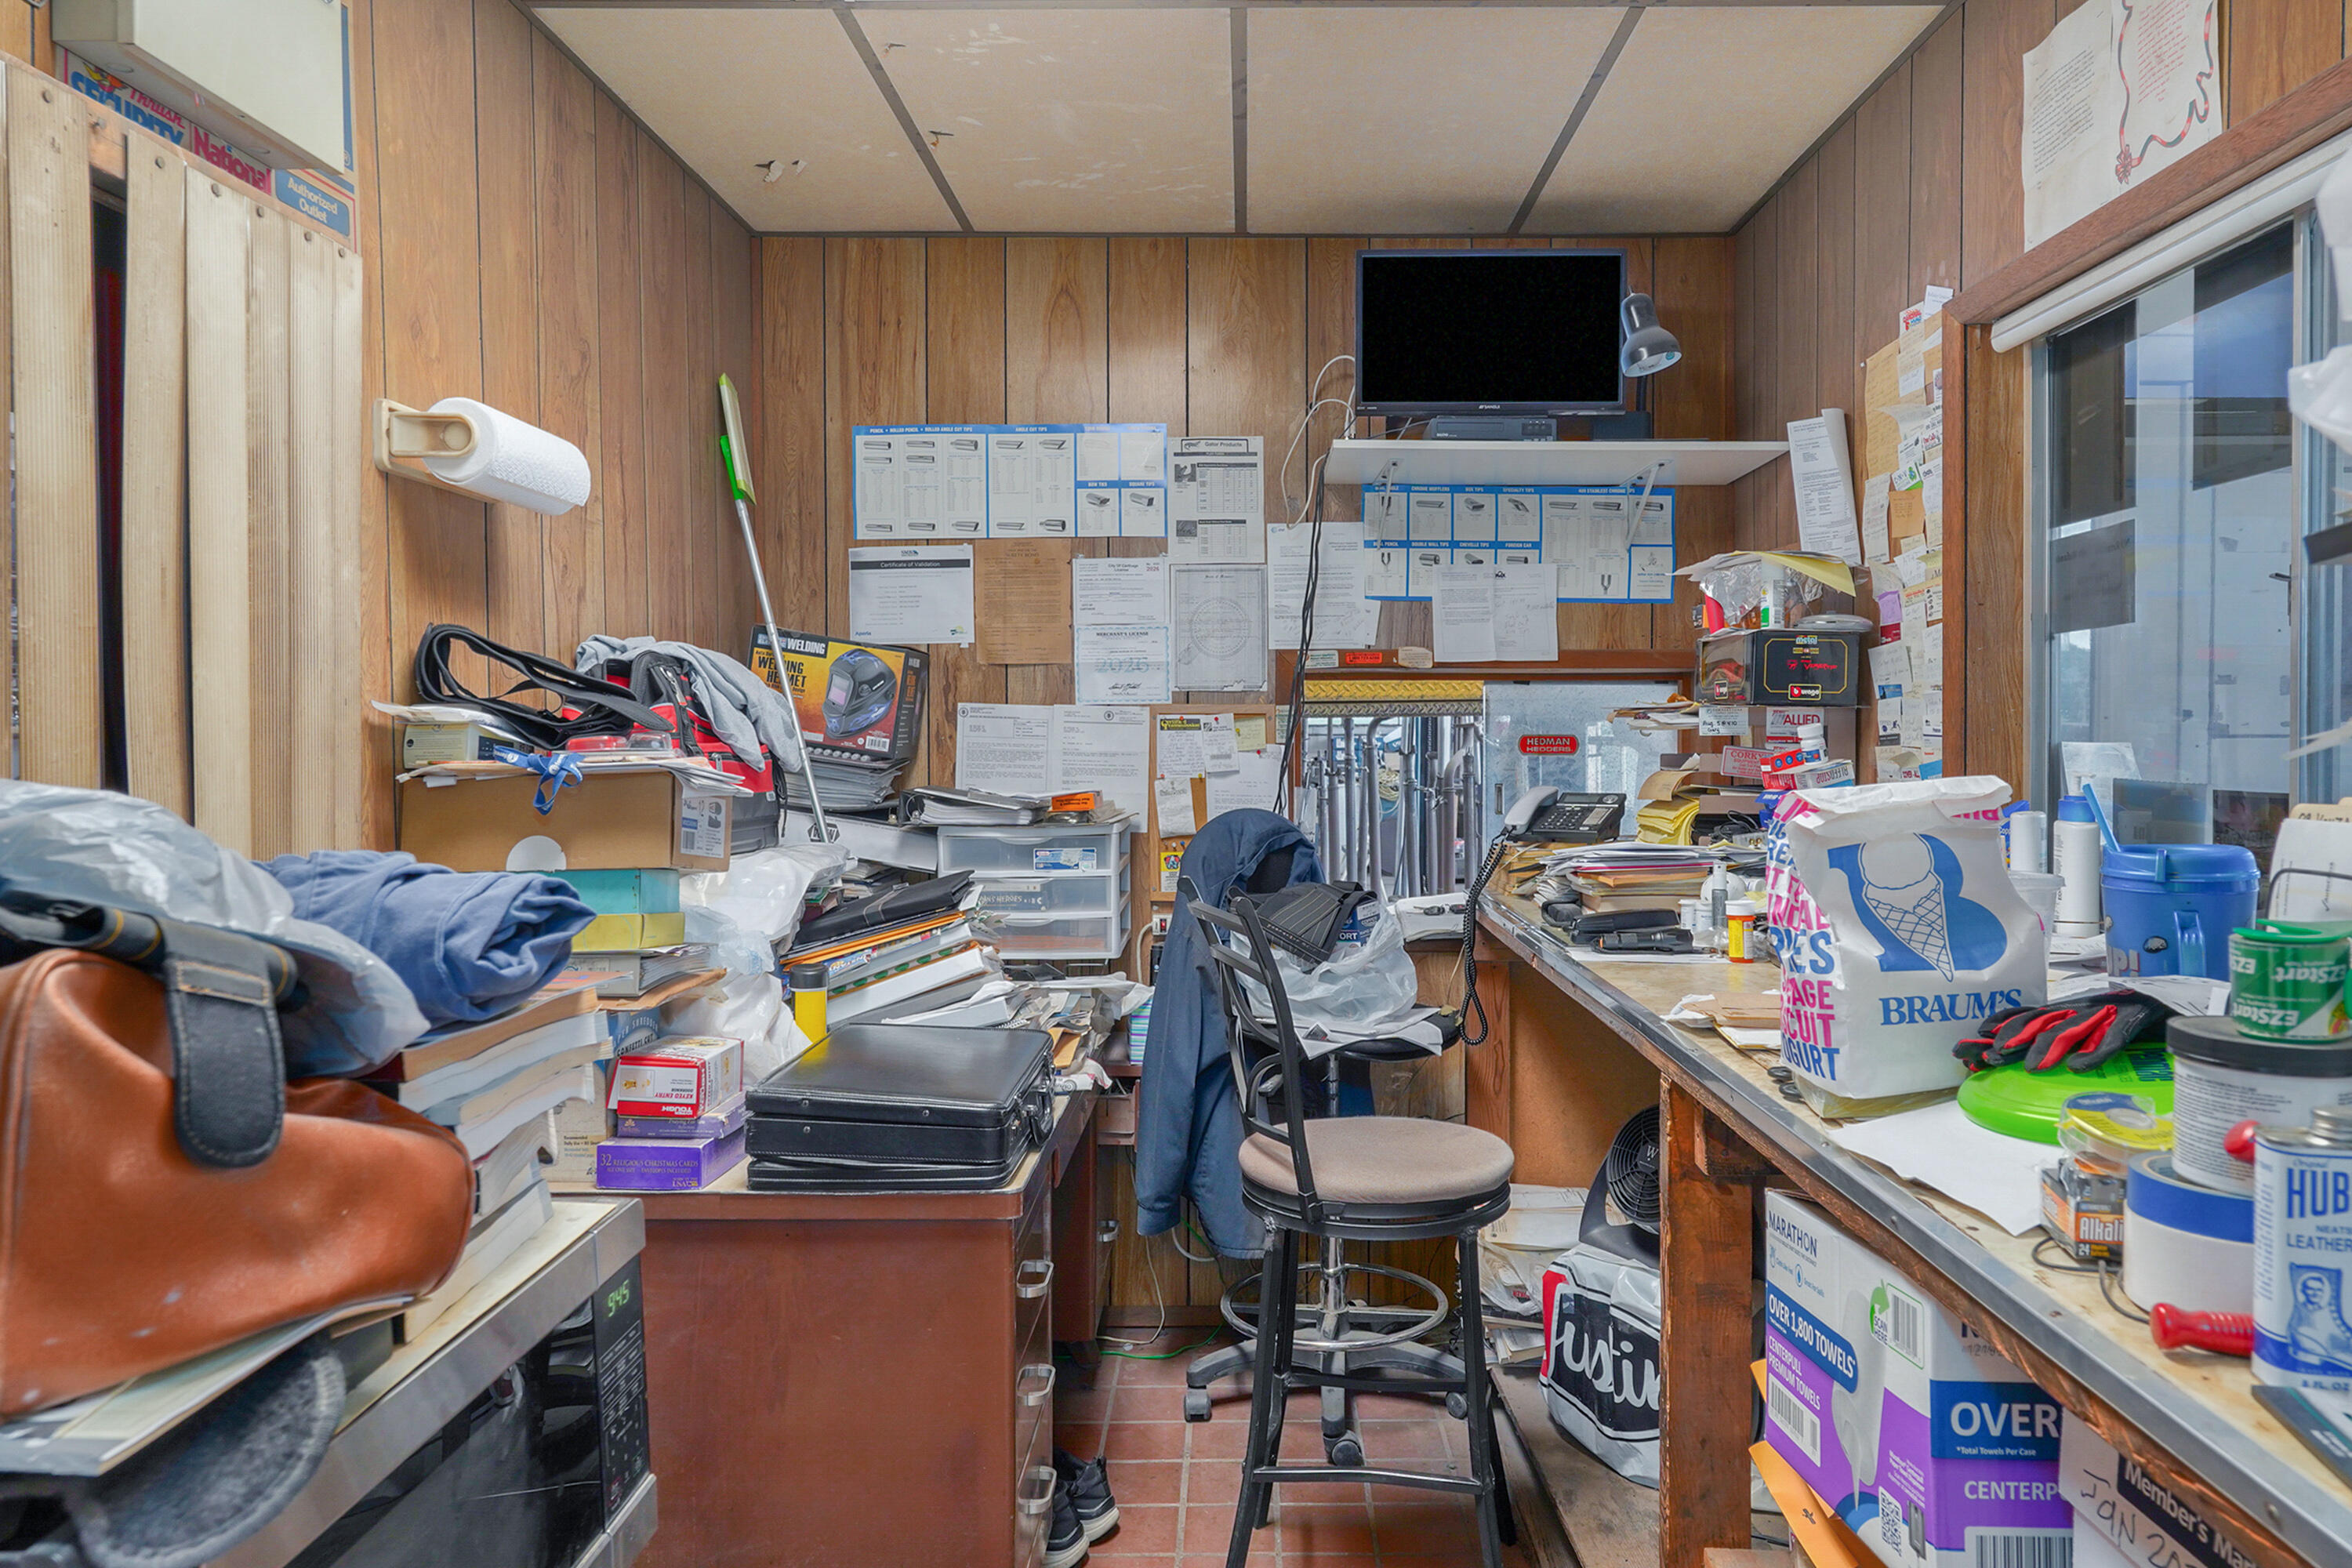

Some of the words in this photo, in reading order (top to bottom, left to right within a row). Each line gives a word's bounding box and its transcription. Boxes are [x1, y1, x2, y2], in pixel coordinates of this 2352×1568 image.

[288, 175, 339, 216] Authorized
[298, 197, 328, 224] Outlet
[787, 637, 826, 655] WELDING
[758, 655, 804, 675] WEING
[766, 670, 808, 688] HEMET
[1783, 713, 1820, 726] ALLIED
[1526, 735, 1570, 746] HEDMAN
[1878, 988, 2022, 1025] BRAUM'S
[616, 1040, 644, 1058] CONFETTI
[644, 1033, 654, 1046] CUT
[600, 1153, 612, 1166] 32
[1769, 1210, 1817, 1258] MARATHON
[1769, 1294, 1790, 1328] OVER
[1791, 1311, 1814, 1347] 1,800
[1873, 1315, 1889, 1333] SCAN
[1768, 1334, 1802, 1377] CENTERPULL
[1768, 1352, 1795, 1385] PREMIUM
[1795, 1374, 1820, 1411] TOWELS
[1951, 1401, 2060, 1439] OVER
[1980, 1446, 2005, 1456] Towels
[2005, 1447, 2018, 1456] Per
[2018, 1447, 2037, 1457] Case
[2123, 1461, 2211, 1546] Member's
